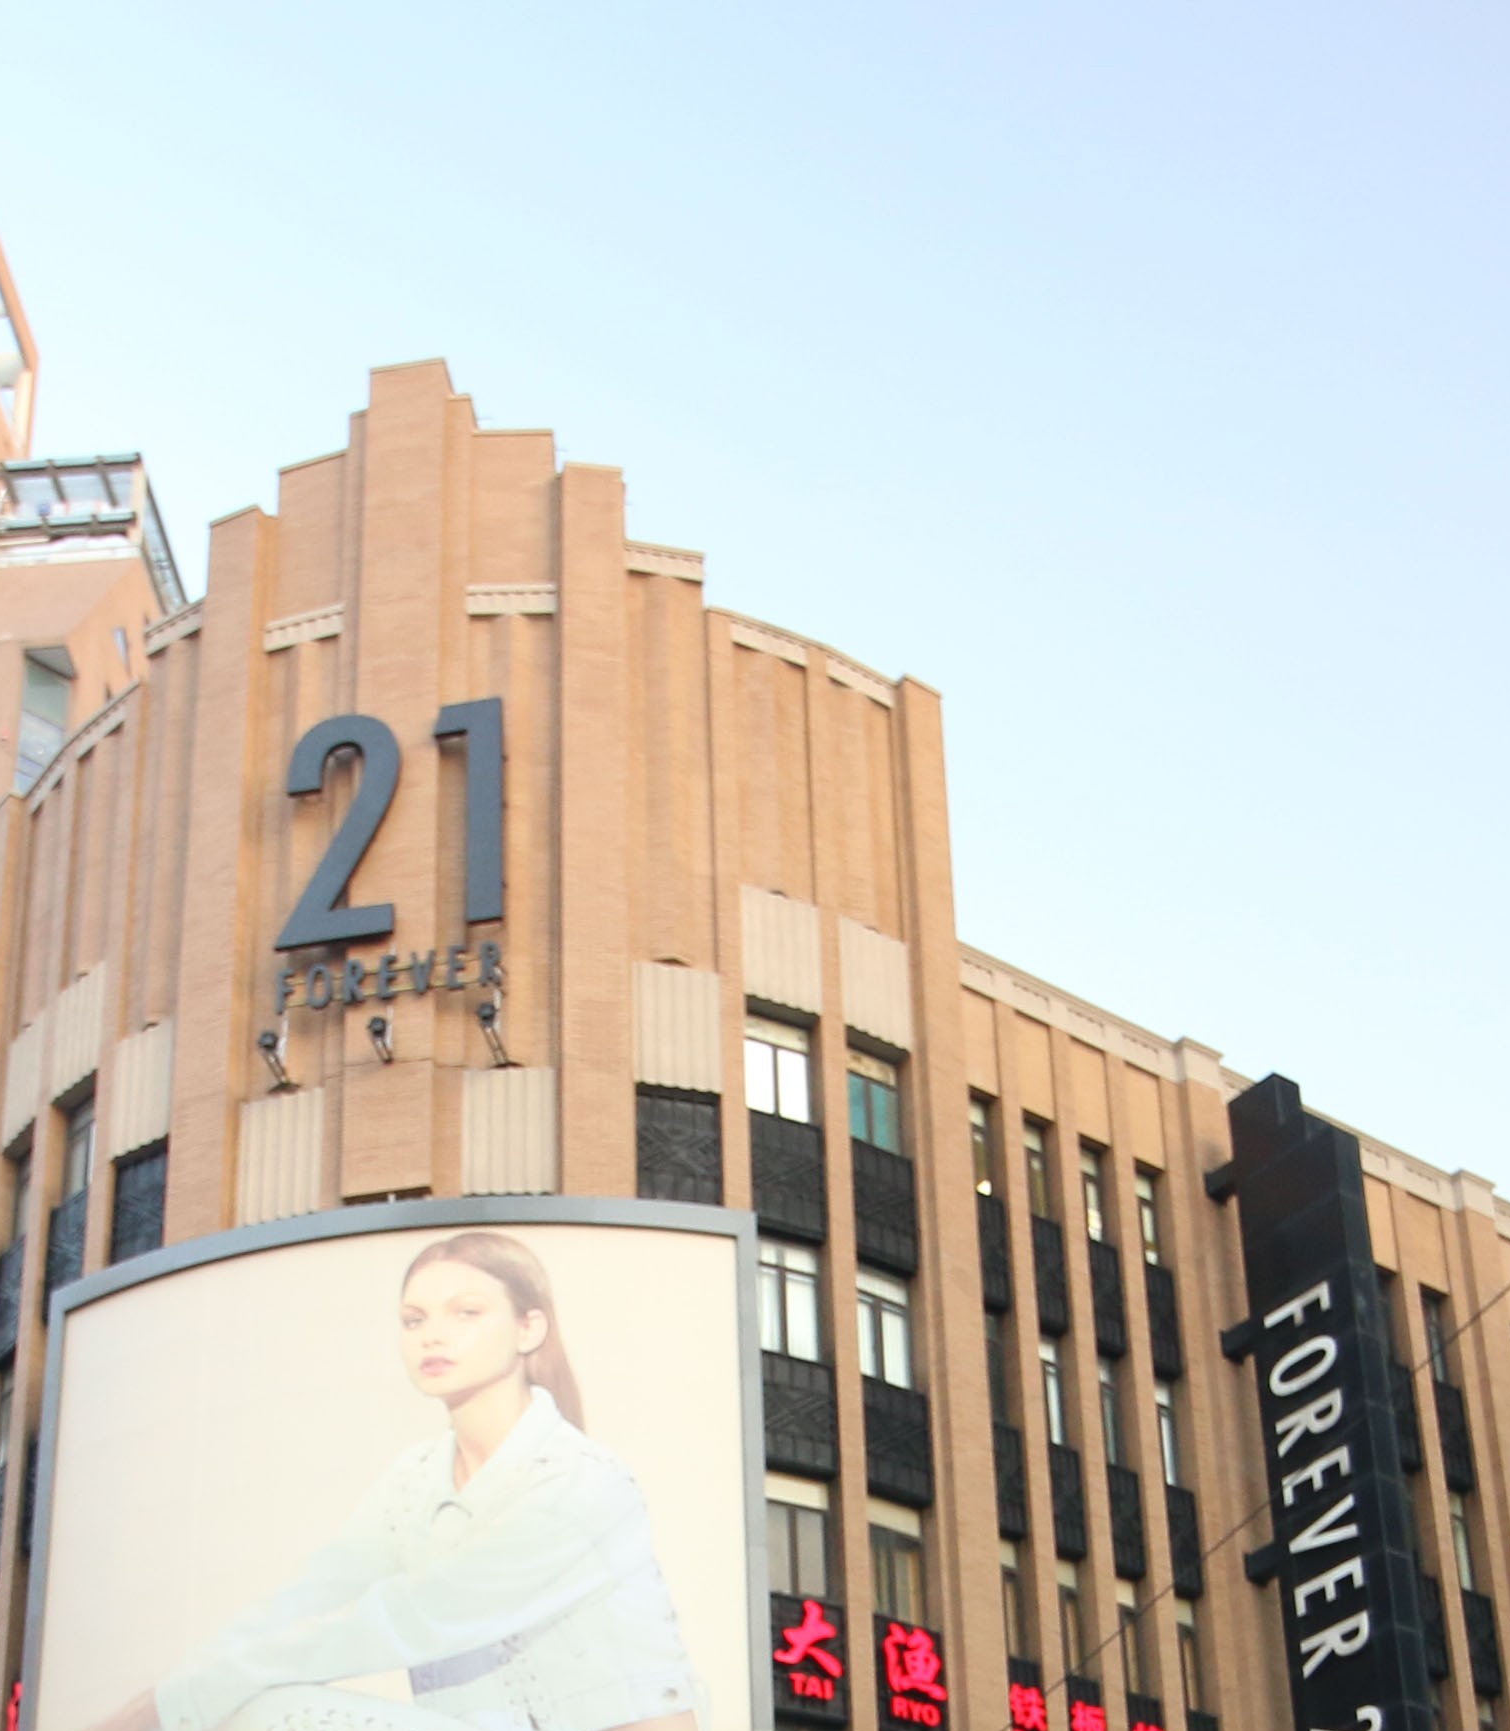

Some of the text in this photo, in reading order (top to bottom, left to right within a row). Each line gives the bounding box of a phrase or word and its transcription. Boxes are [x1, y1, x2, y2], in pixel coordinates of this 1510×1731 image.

[275, 697, 504, 951] 21
[274, 941, 504, 1016] FOREVER
[1263, 1280, 1371, 1680] FOREVER
[774, 1599, 842, 1679] 大
[884, 1622, 948, 1701] 渔
[791, 1672, 835, 1700] TAI
[892, 1697, 941, 1727] RYO
